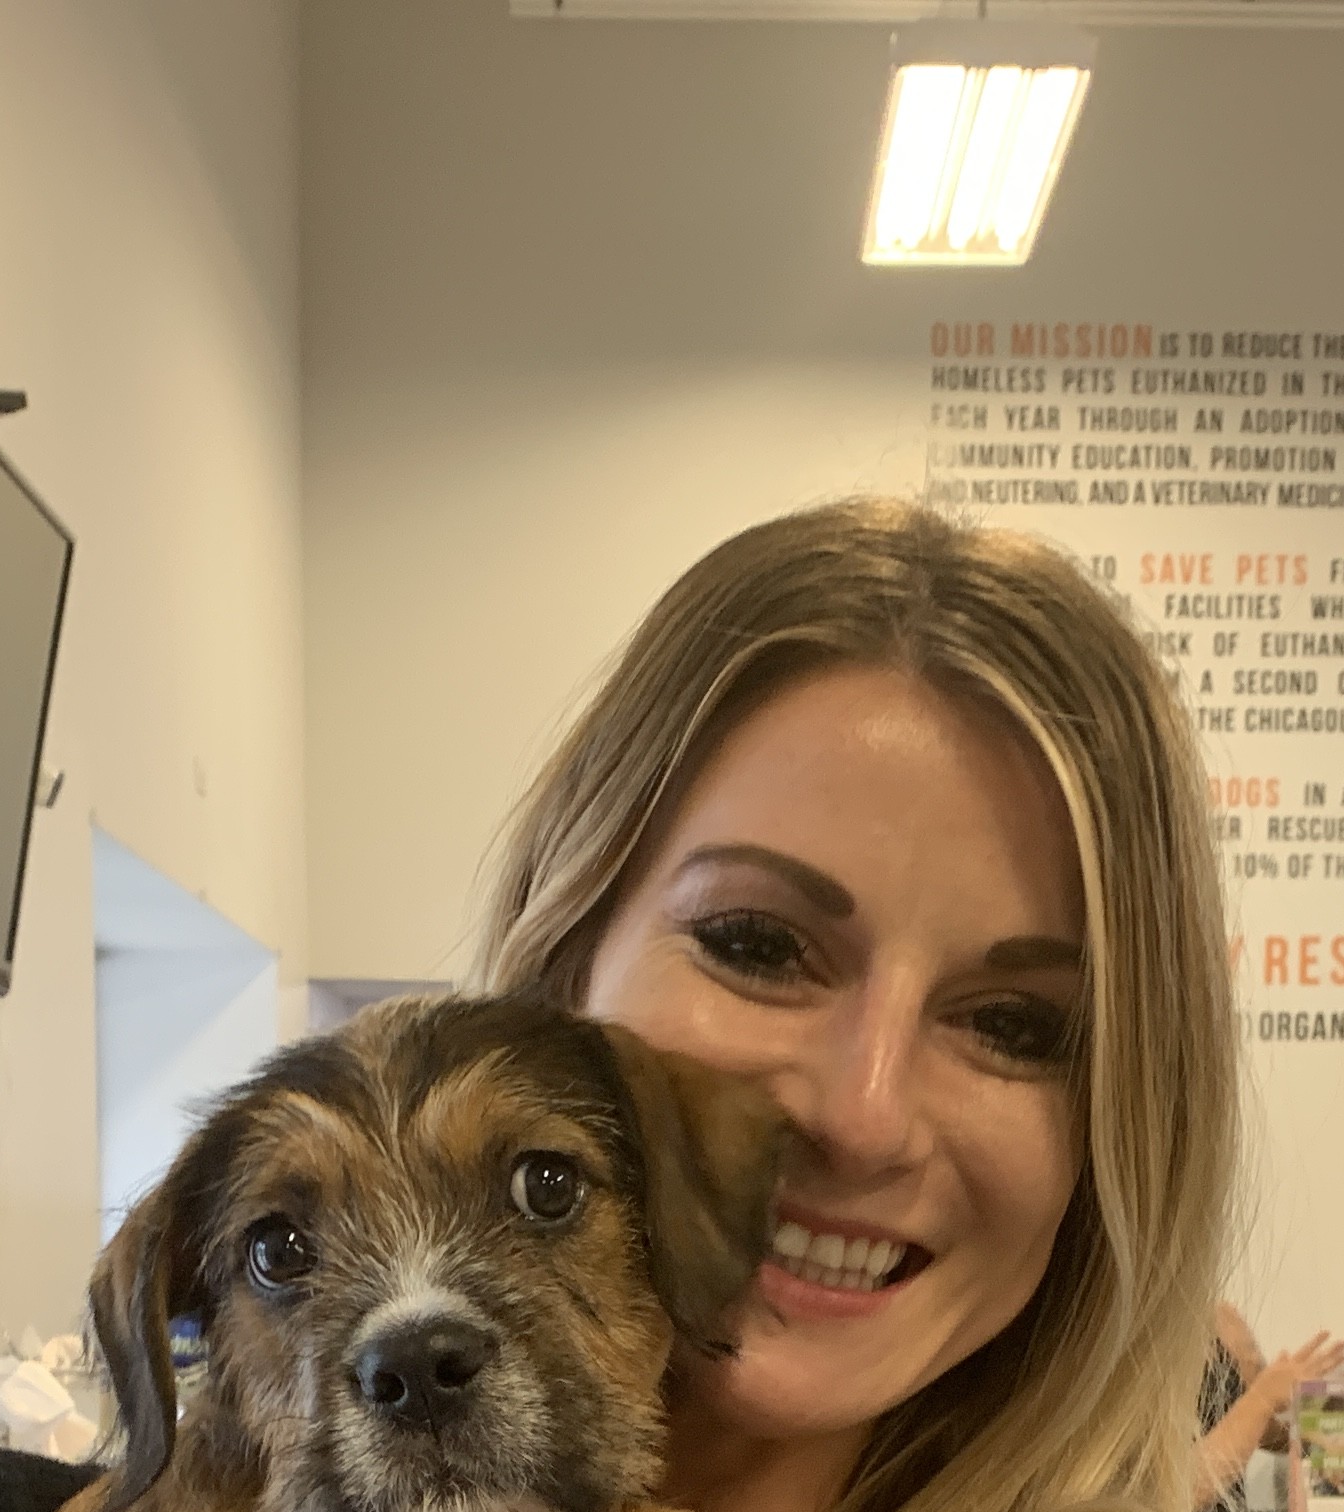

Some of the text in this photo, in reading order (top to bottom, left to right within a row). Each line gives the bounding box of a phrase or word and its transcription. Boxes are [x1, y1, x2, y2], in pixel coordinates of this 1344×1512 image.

[931, 321, 995, 358] OUR
[1011, 322, 1153, 358] MISSION
[1159, 332, 1179, 358] IS
[1188, 332, 1214, 358] TO
[1221, 332, 1301, 359] REDUCE
[931, 366, 1046, 393] HOMELESS
[1061, 367, 1115, 394] PETS
[1131, 368, 1267, 396] EUTHANIZED
[1281, 371, 1304, 396] IN
[1004, 405, 1060, 431] YEAR
[1077, 406, 1178, 432] THROUGH
[1194, 408, 1224, 433] AN
[1210, 446, 1336, 472] PROMOTION
[1089, 480, 1129, 505] AND
[1132, 481, 1146, 505] A
[1151, 481, 1271, 506] VETERINARY
[1091, 555, 1117, 582] TO
[1139, 554, 1214, 585] SAVE
[1236, 554, 1308, 586] PETS
[1164, 593, 1282, 619] FACILITIES
[1213, 632, 1238, 657] OF
[1200, 670, 1213, 694] A
[1233, 670, 1318, 695] SECOND
[1198, 707, 1235, 732] THE
[1305, 782, 1327, 807] IN
[1233, 853, 1279, 879] 10%
[1287, 853, 1314, 880] OF
